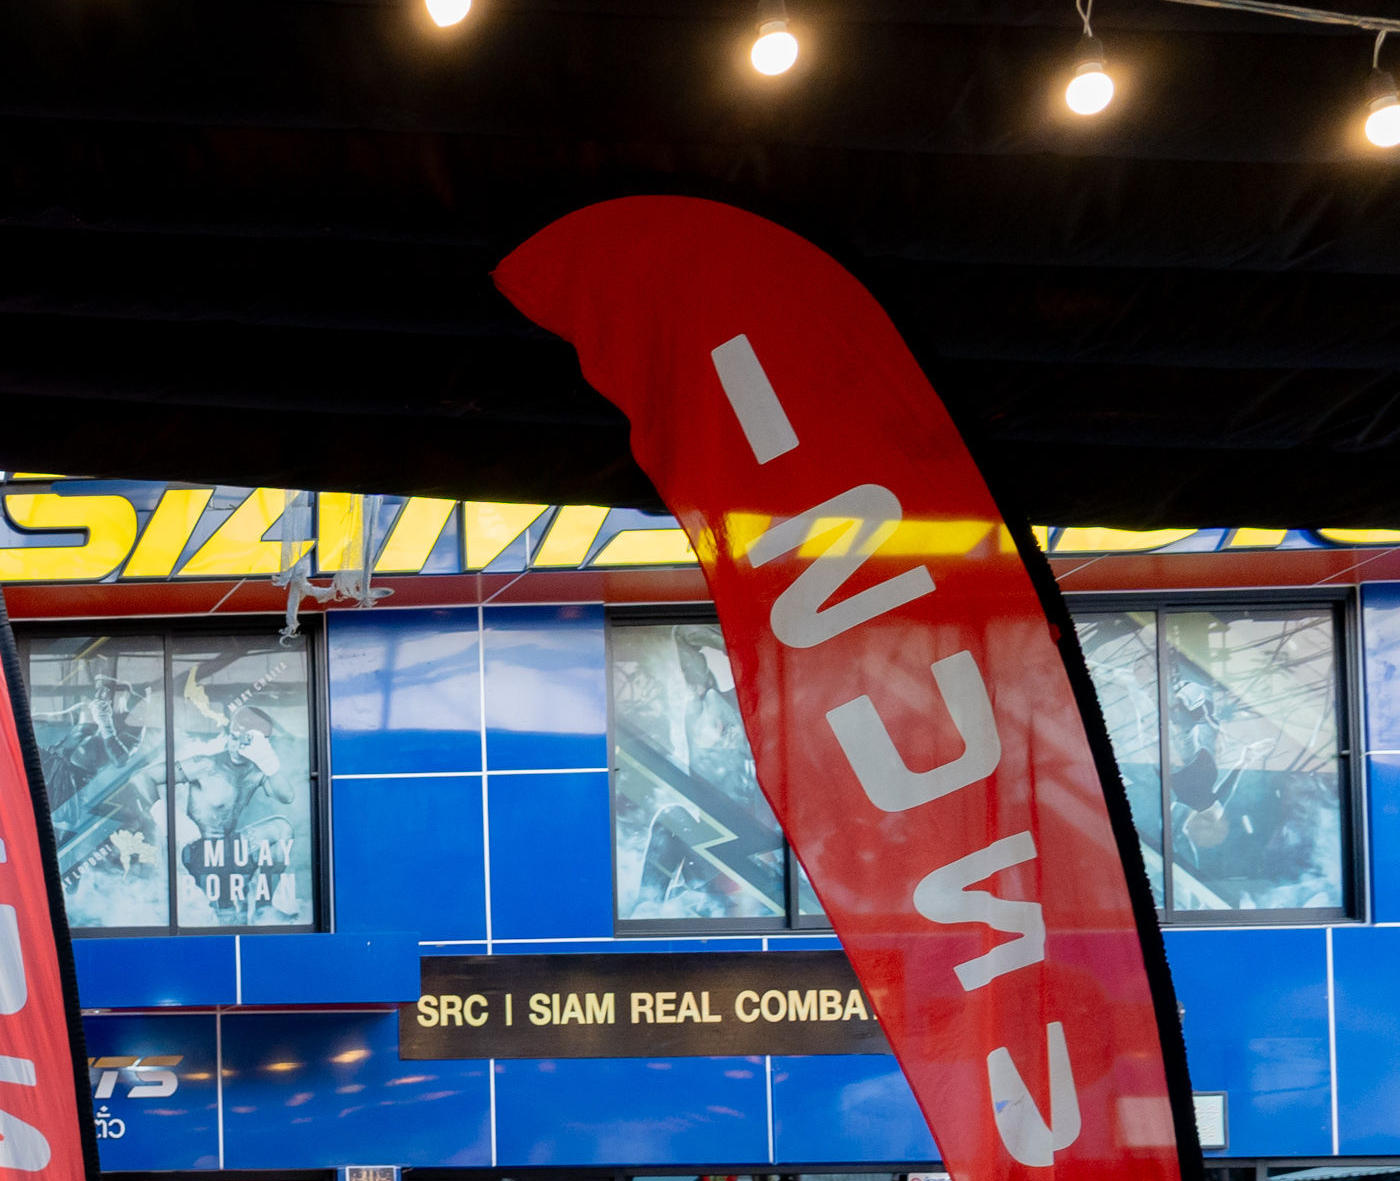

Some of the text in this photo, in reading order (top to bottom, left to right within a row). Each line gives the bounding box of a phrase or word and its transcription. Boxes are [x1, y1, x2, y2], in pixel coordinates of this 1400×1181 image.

[204, 839, 294, 867] MUAY
[416, 994, 488, 1027] SRC
[528, 992, 615, 1025] SIAM
[631, 991, 722, 1024] REAL
[734, 989, 879, 1023] COMBA
